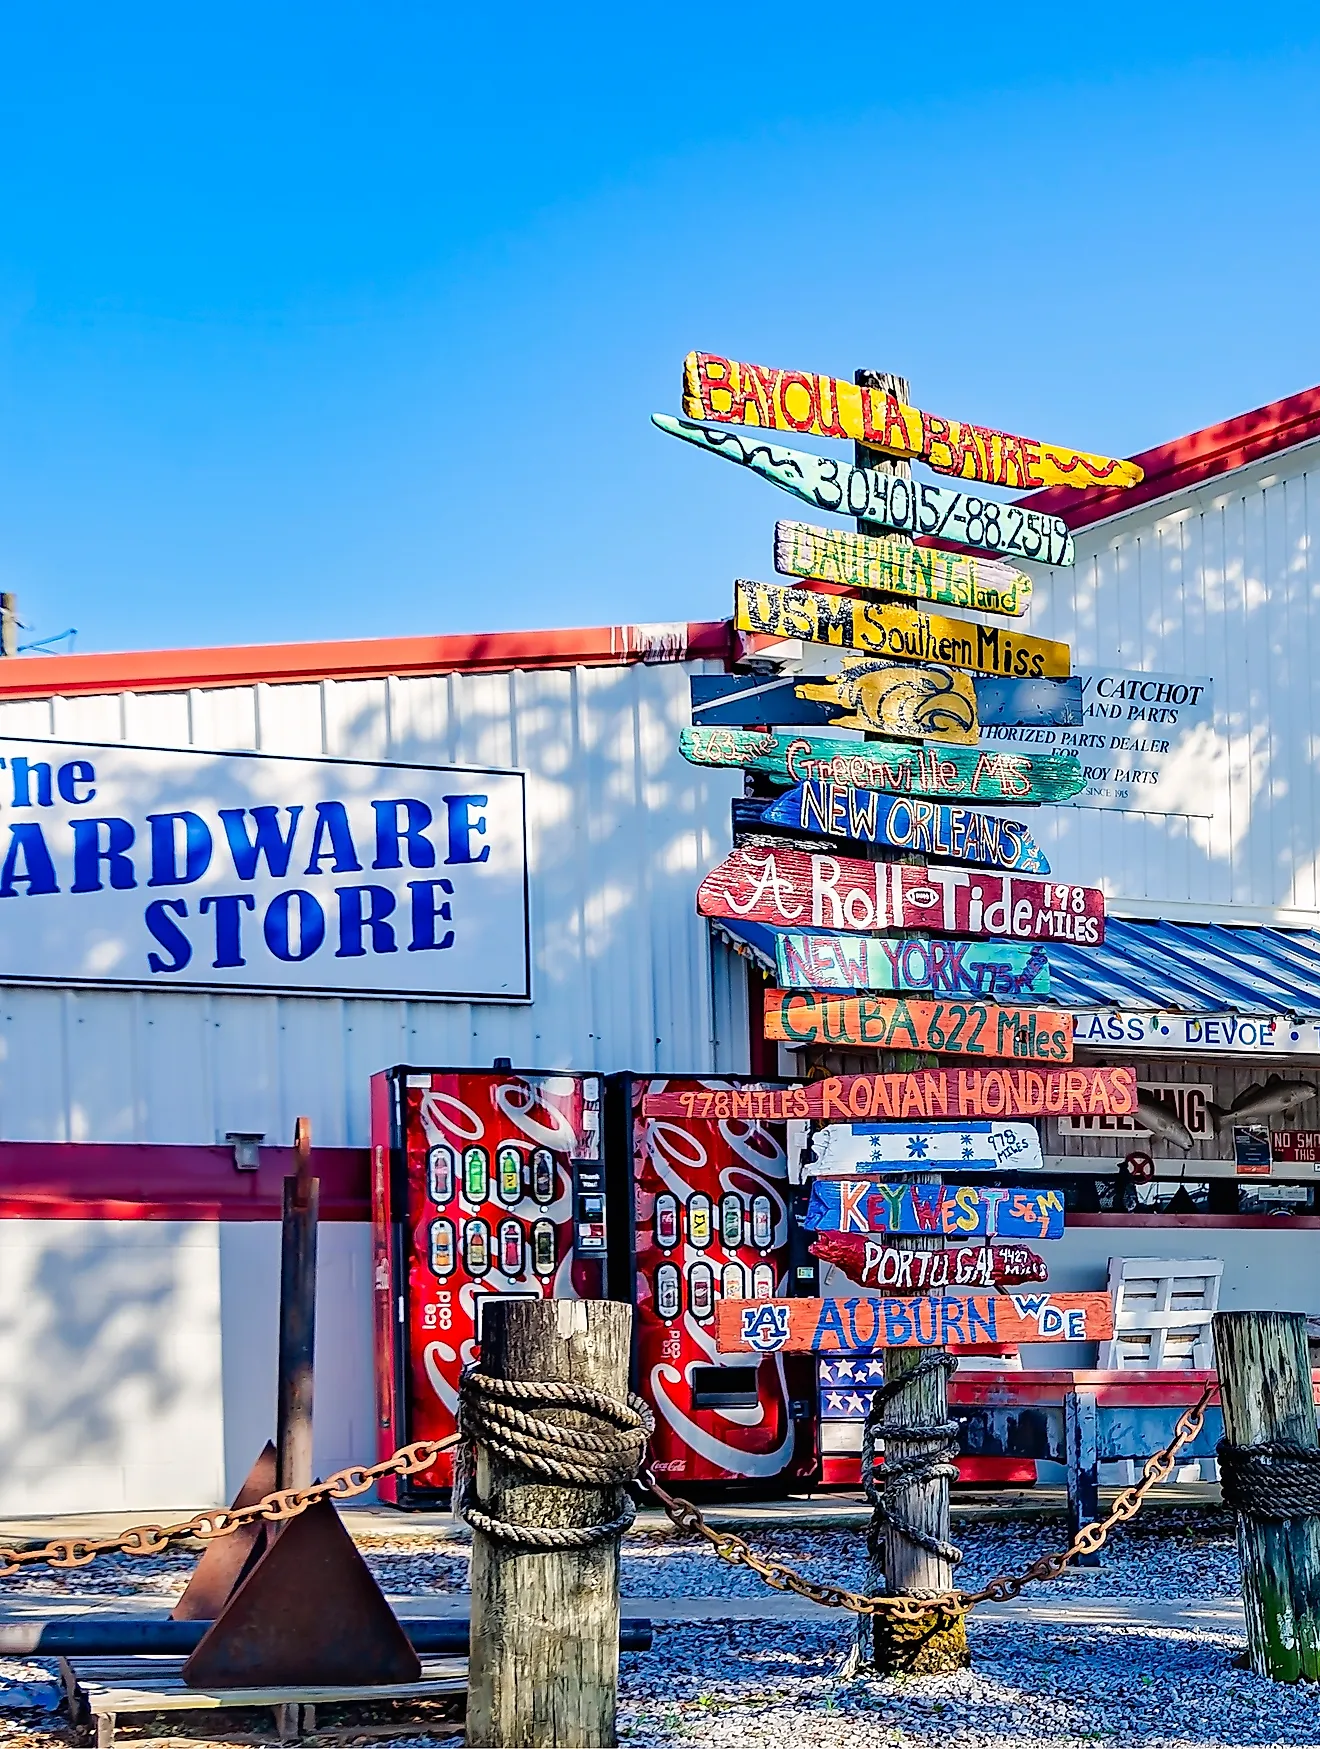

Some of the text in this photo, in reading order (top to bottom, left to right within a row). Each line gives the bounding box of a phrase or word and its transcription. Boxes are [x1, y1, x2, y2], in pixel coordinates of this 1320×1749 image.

[699, 352, 1044, 489] BAYOU LA BATRE
[793, 524, 1017, 612] DAUPHIN Island
[737, 580, 1046, 678] USM Southern Miss
[1097, 677, 1205, 706] CATCHOT
[1082, 703, 1179, 724] AND PARTS
[979, 726, 1170, 753] THORIZED PARTS DEALER
[0, 756, 97, 808] he
[971, 751, 1033, 797] MS
[1082, 766, 1159, 785] ROY PARTS
[1085, 787, 1112, 798] SINCE
[800, 779, 879, 842] NEW
[886, 797, 1022, 868] ORLEANS
[0, 794, 491, 898] ARDWARE
[812, 854, 904, 930] Roll
[928, 867, 1035, 936] Tide
[1043, 884, 1086, 914] 198
[144, 878, 456, 974] STORE
[1034, 910, 1100, 943] MILES
[783, 938, 869, 988] NEW
[885, 940, 973, 992] YORK
[928, 1002, 988, 1053] 622
[997, 1010, 1067, 1060] Miles
[1072, 1014, 1145, 1041] LASS
[1185, 1020, 1276, 1047] DEVOE
[822, 1070, 953, 1118] ROATAN
[958, 1066, 1133, 1117] HONDURAS
[987, 1129, 1017, 1151] 978
[996, 1138, 1030, 1164] MILES
[1274, 1132, 1291, 1148] NO
[1294, 1148, 1316, 1161] THIS
[861, 1239, 997, 1288] PORTUGAL
[999, 1248, 1029, 1264] 4427
[436, 1290, 453, 1331] cold
[810, 1297, 997, 1350] AUBURN
[670, 1329, 682, 1360] cold
